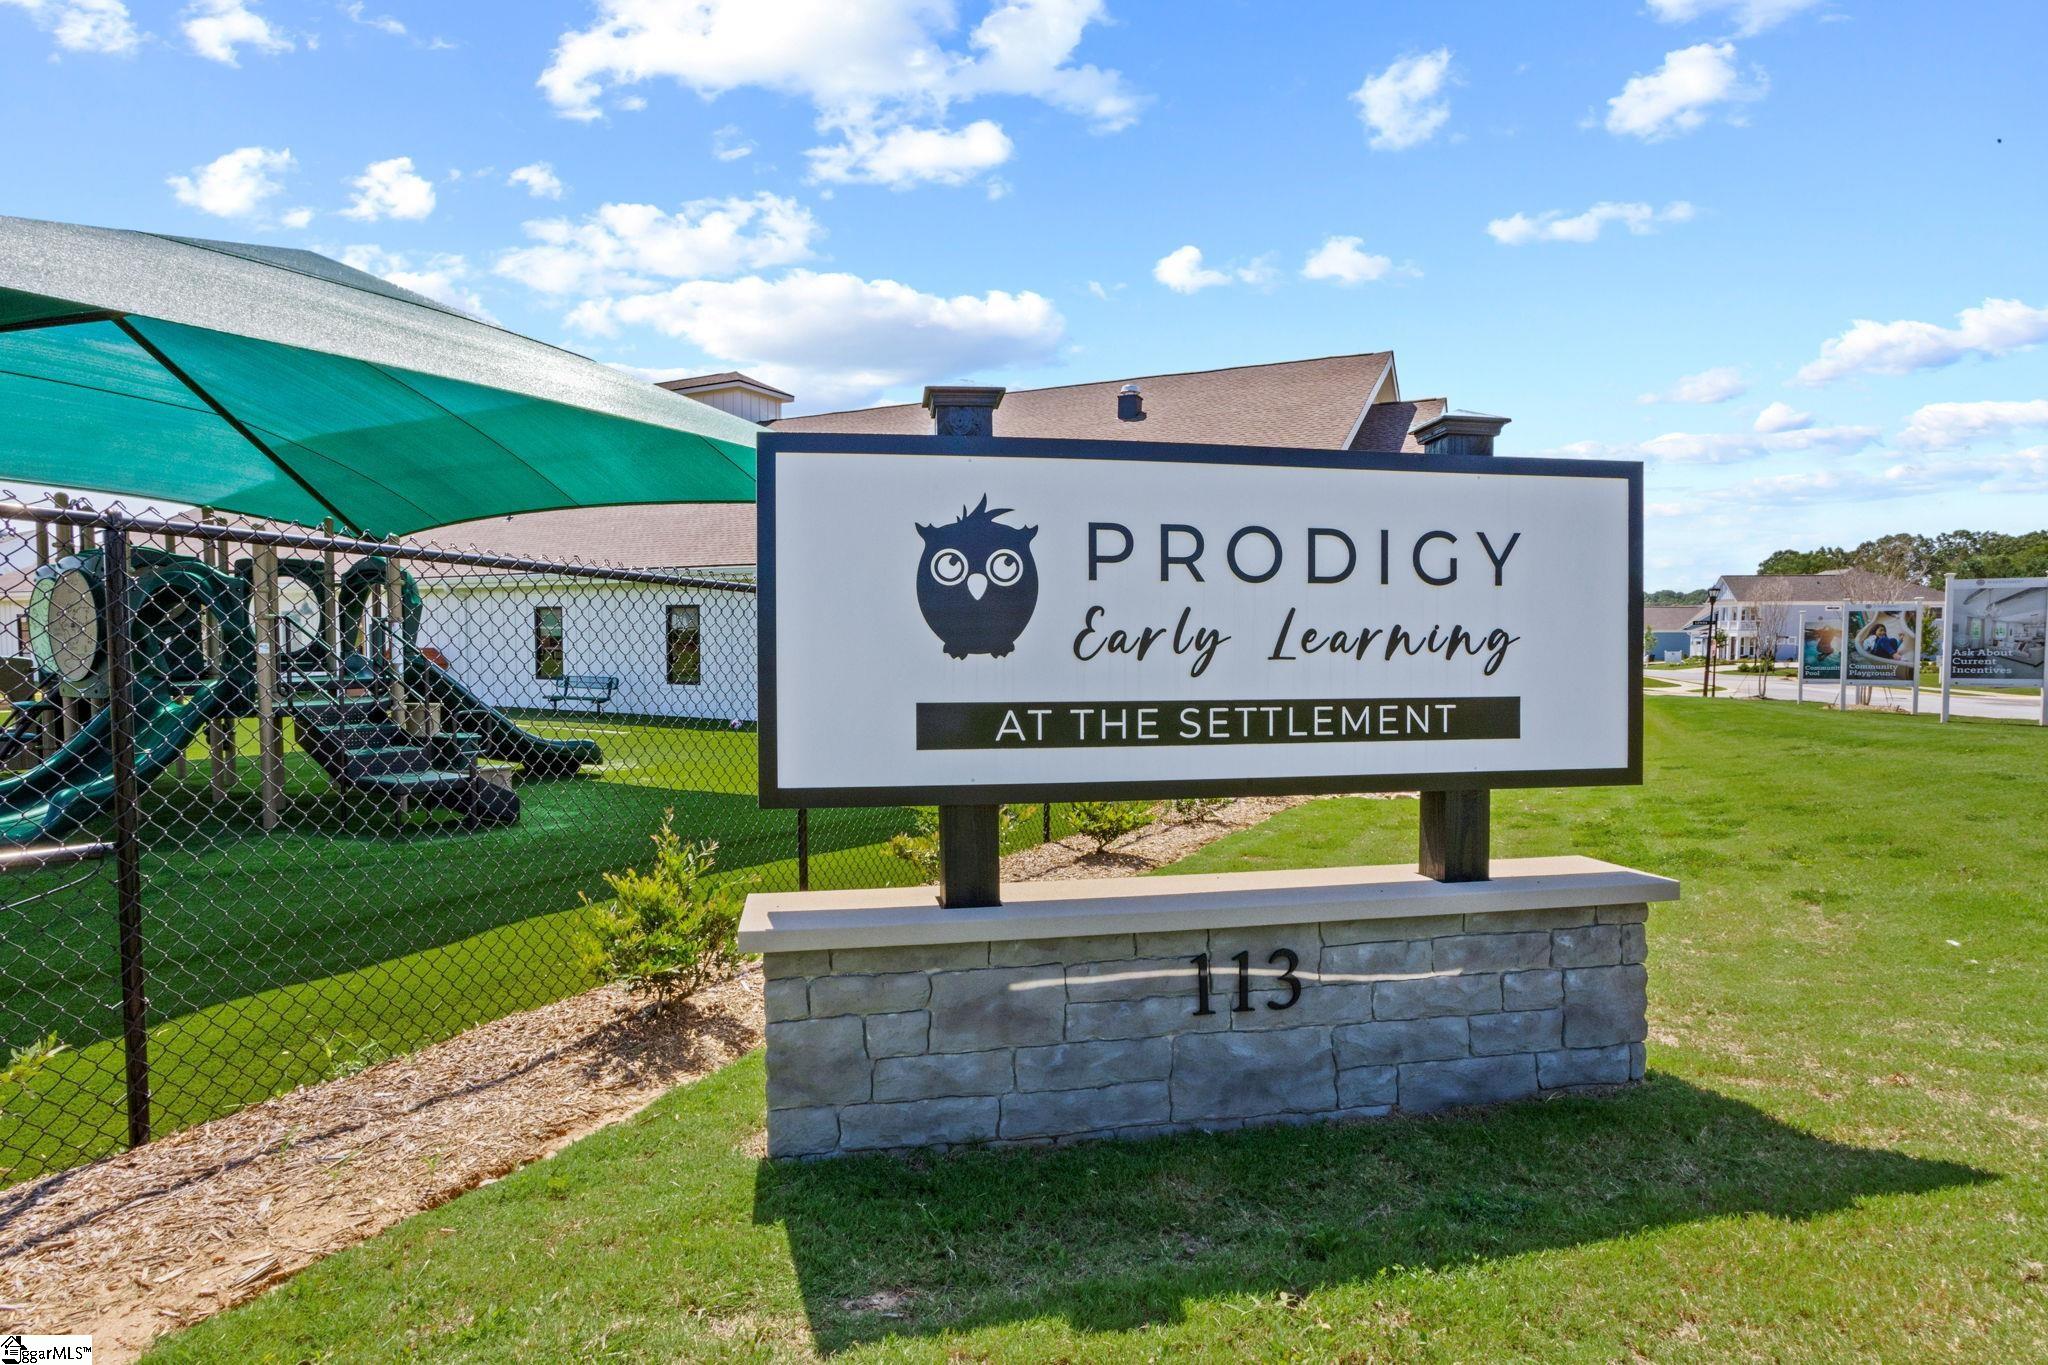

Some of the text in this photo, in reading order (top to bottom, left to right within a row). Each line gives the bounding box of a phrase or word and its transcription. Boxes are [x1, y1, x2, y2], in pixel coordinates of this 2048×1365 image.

[1088, 521, 1521, 586] PRODIGY
[1073, 605, 1521, 678] Early Learning
[1952, 648, 2013, 657] Ask About
[1952, 657, 1997, 665] Current
[1952, 666, 2012, 674] Incentives
[995, 703, 1457, 741] AT THE SETTLEMENT
[1189, 947, 1303, 1017] 113
